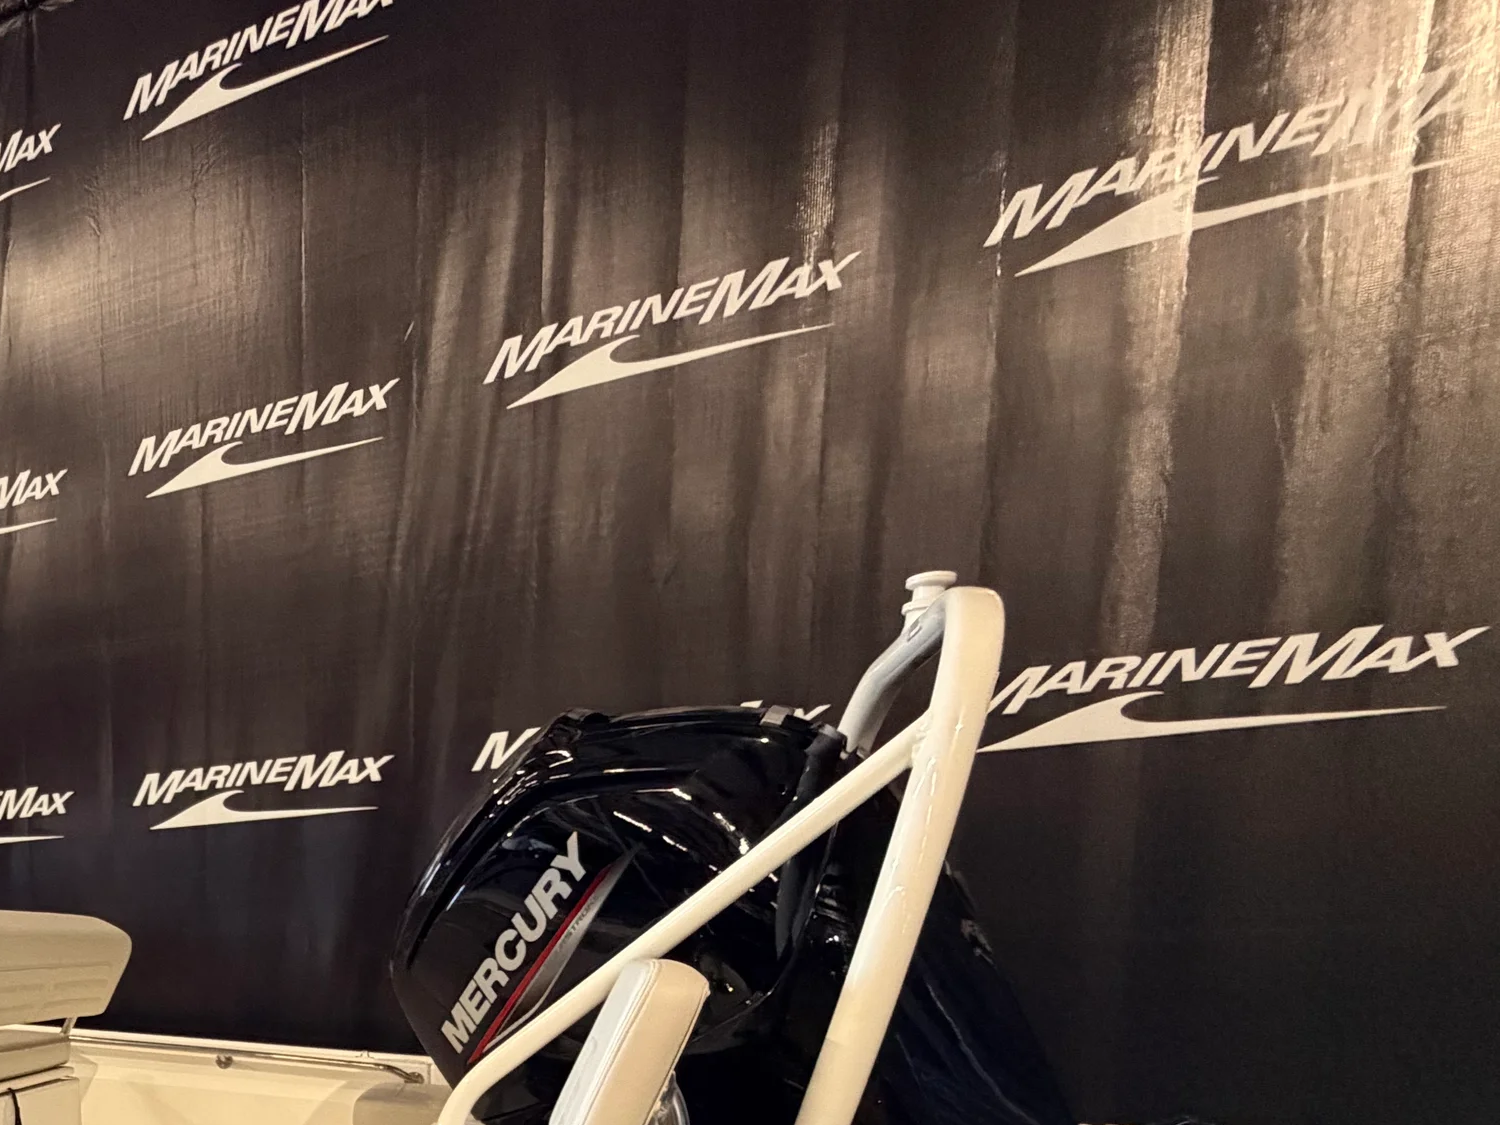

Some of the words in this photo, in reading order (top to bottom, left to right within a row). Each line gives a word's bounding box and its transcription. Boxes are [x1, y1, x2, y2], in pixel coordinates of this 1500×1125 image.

[484, 251, 862, 384] MARINEMAX
[128, 378, 400, 476] MARINEMAX
[987, 624, 1491, 715] MARINEMAX
[132, 750, 395, 807] MARINEMAX
[441, 831, 587, 1054] MERCURY
